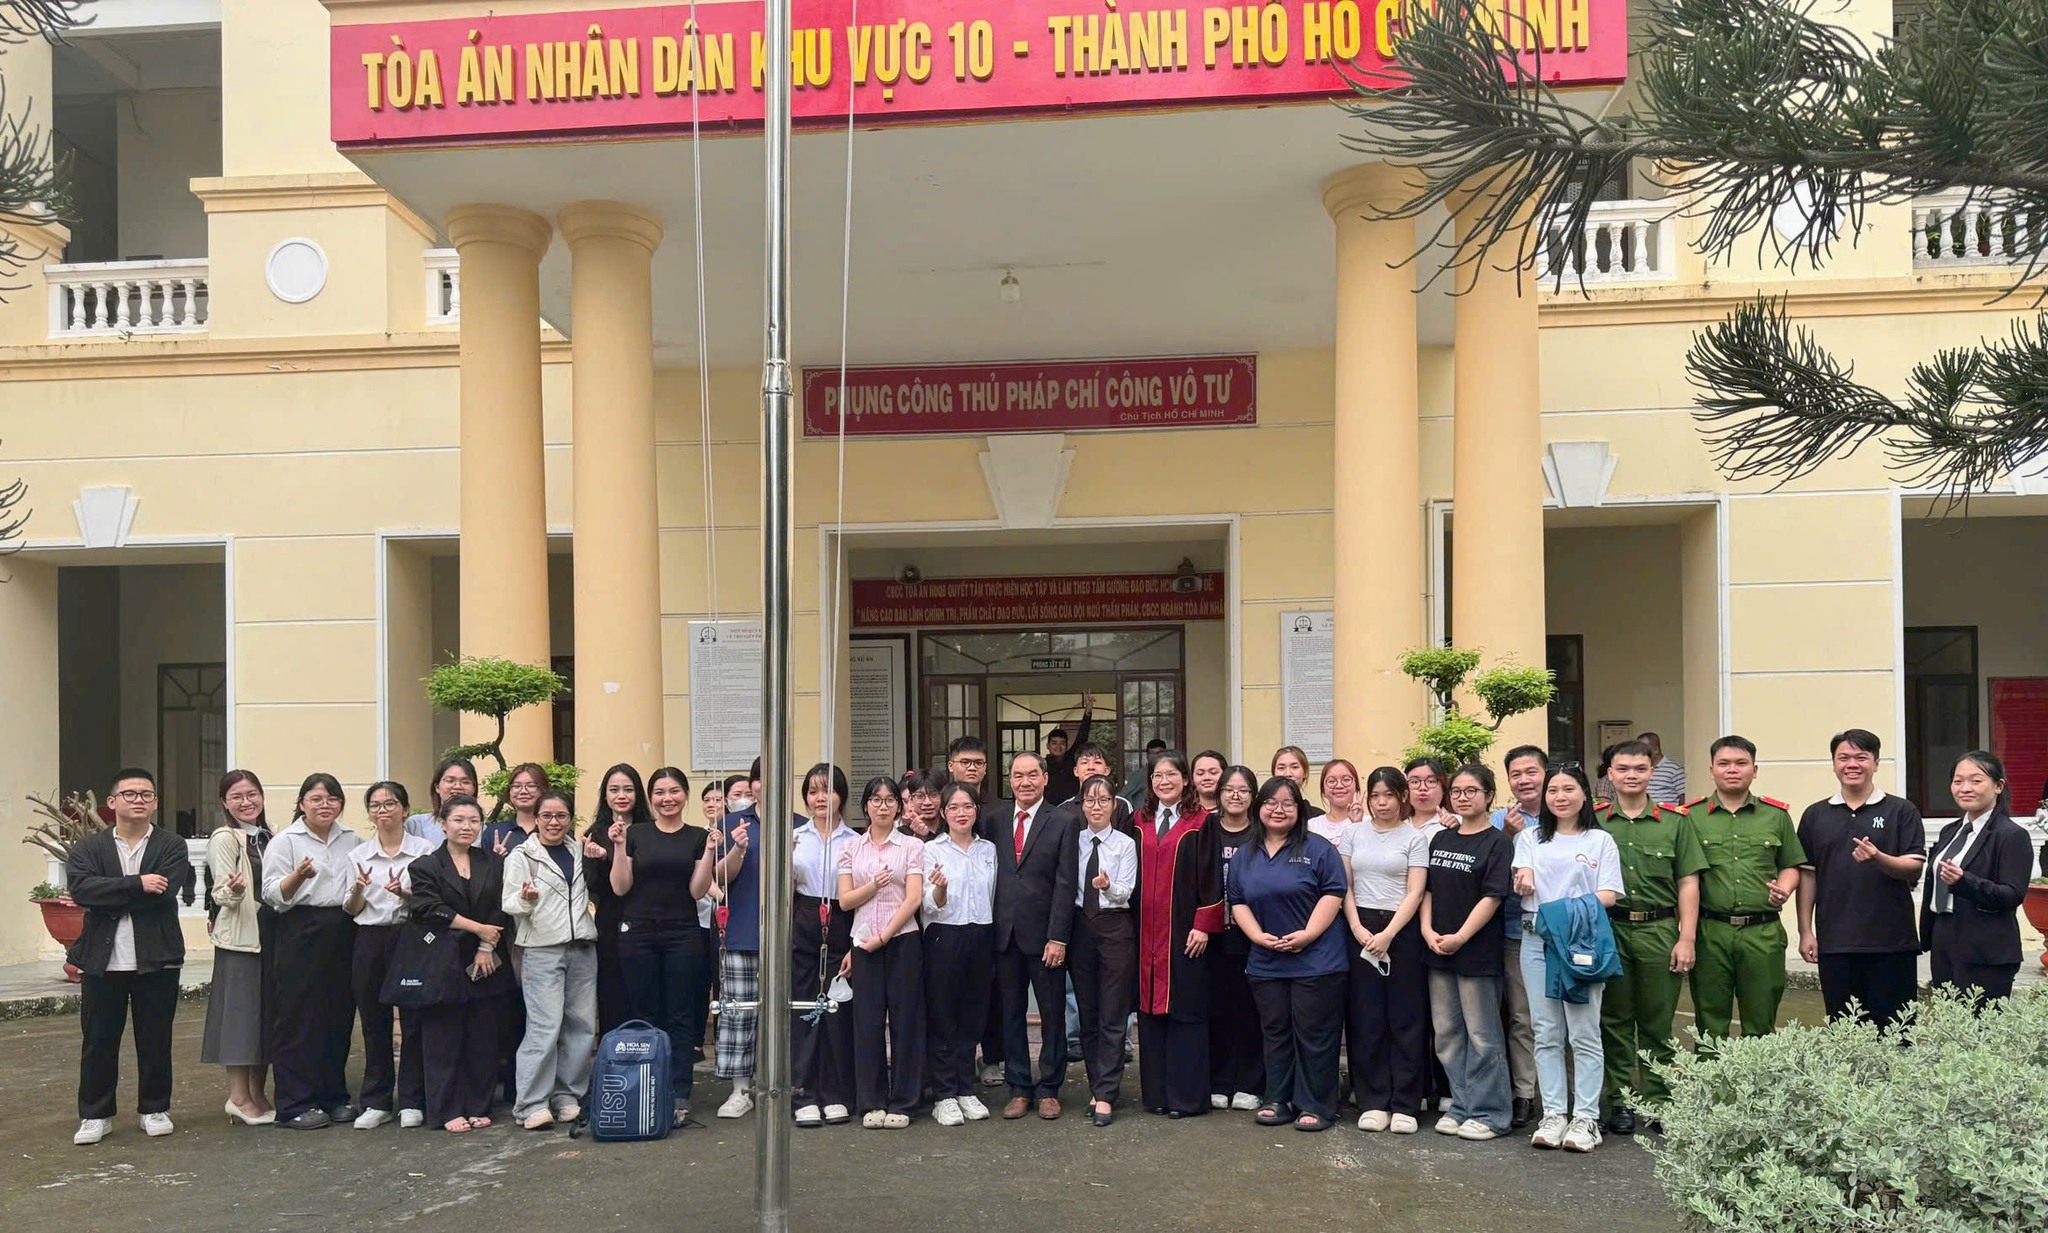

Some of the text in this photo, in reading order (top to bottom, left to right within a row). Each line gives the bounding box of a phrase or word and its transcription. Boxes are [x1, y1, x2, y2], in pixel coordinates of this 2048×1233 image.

[362, 35, 443, 109] TÒA
[457, 29, 513, 103] ÁN
[526, 24, 640, 101] NHÂN
[653, 19, 735, 96] DÂN
[846, 18, 932, 101] VỰC
[948, 20, 994, 81] 10
[1013, 41, 1029, 56] -
[1048, 0, 1188, 77] THÀNH
[825, 367, 1233, 422] PHỤNG CÔNG THỦ PHÁP CHÍ CÔNG VÔ TƯ
[1120, 412, 1139, 421] Chủ
[1142, 411, 1161, 421] Tịch
[1181, 408, 1197, 418] CHÍ
[1200, 409, 1225, 418] MINH
[599, 1074, 628, 1129] HSU
